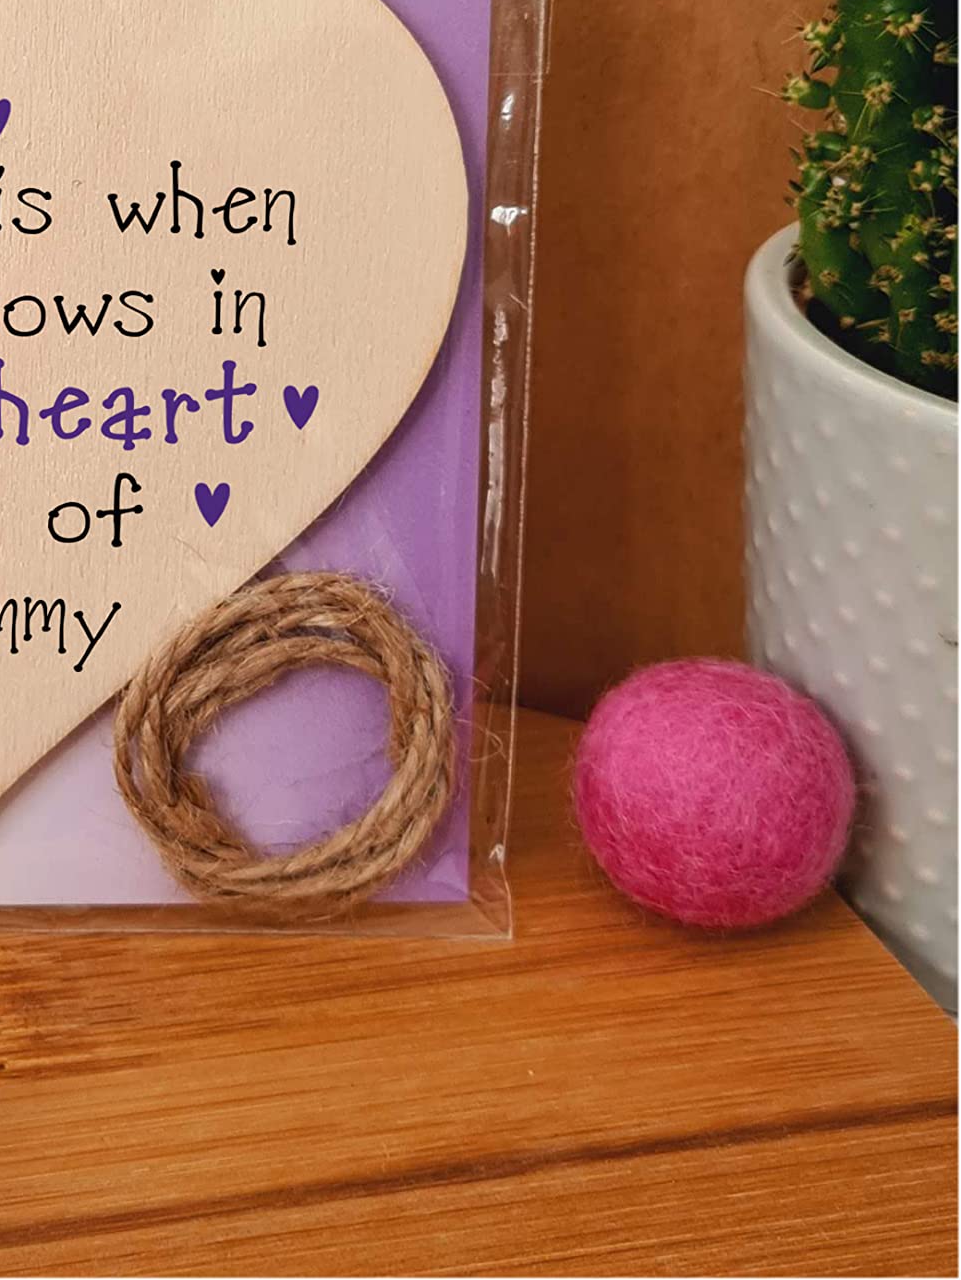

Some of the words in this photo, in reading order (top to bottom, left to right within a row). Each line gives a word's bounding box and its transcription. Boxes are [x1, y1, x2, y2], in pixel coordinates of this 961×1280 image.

[108, 160, 297, 246] when
[210, 268, 267, 348] in
[47, 472, 144, 548] of
